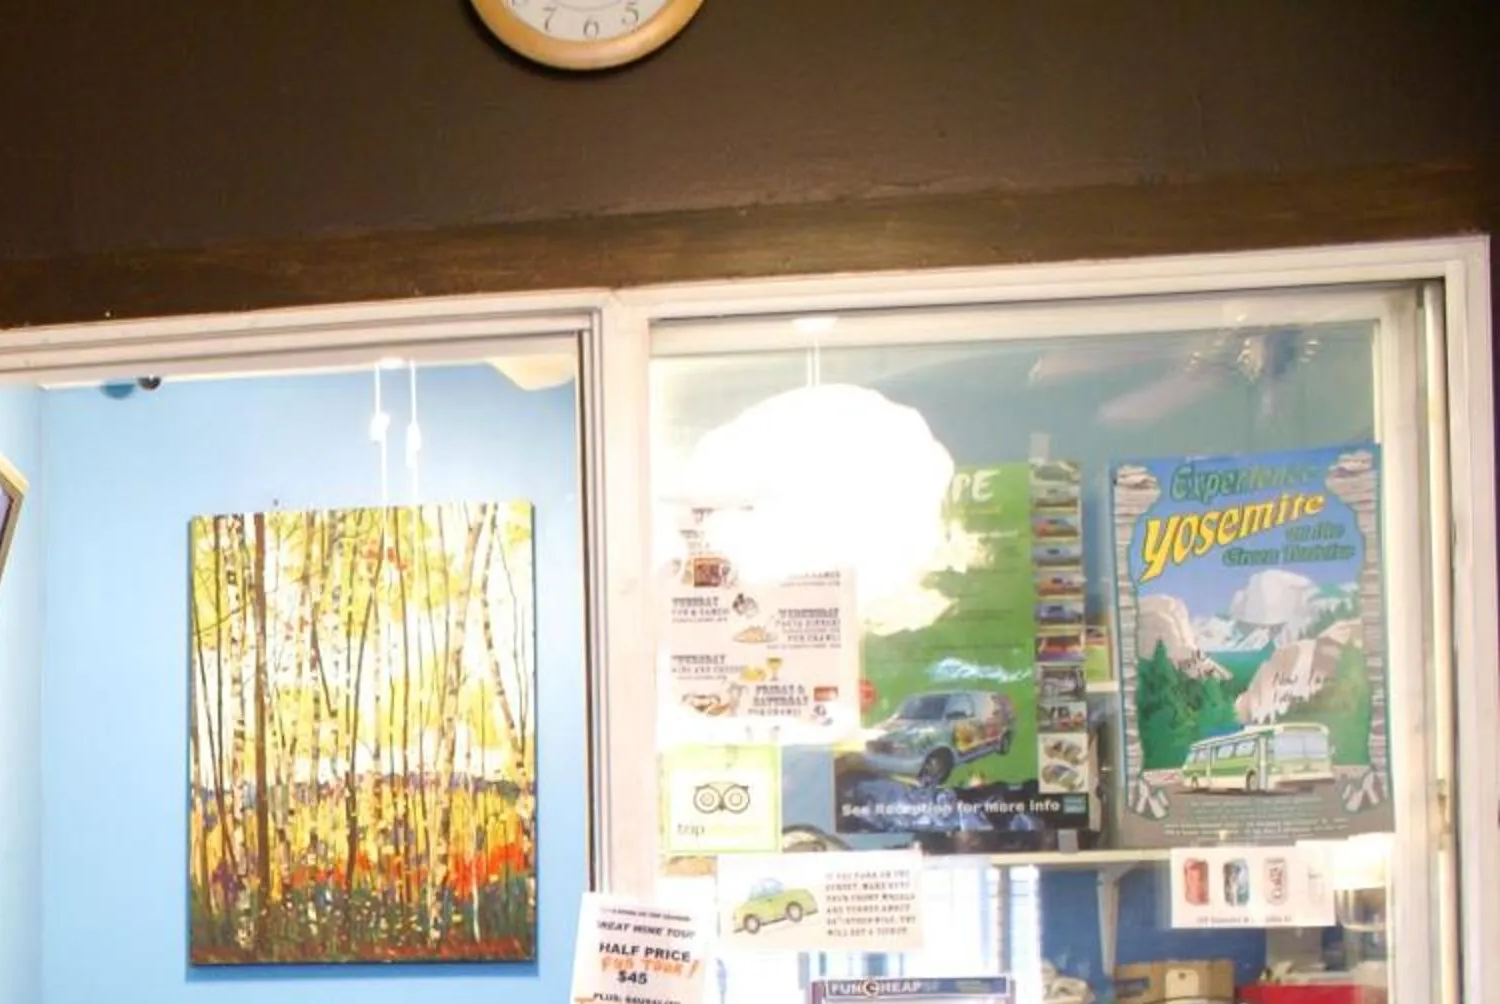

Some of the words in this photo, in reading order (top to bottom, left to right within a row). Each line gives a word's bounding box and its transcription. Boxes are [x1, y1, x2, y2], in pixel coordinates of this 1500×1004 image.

[1139, 493, 1325, 583] Yosemite
[957, 800, 982, 814] for
[1029, 799, 1060, 813] Info
[633, 923, 664, 937] WINE
[598, 941, 641, 956] HALF
[643, 946, 692, 963] PRICE
[617, 969, 648, 986] $45
